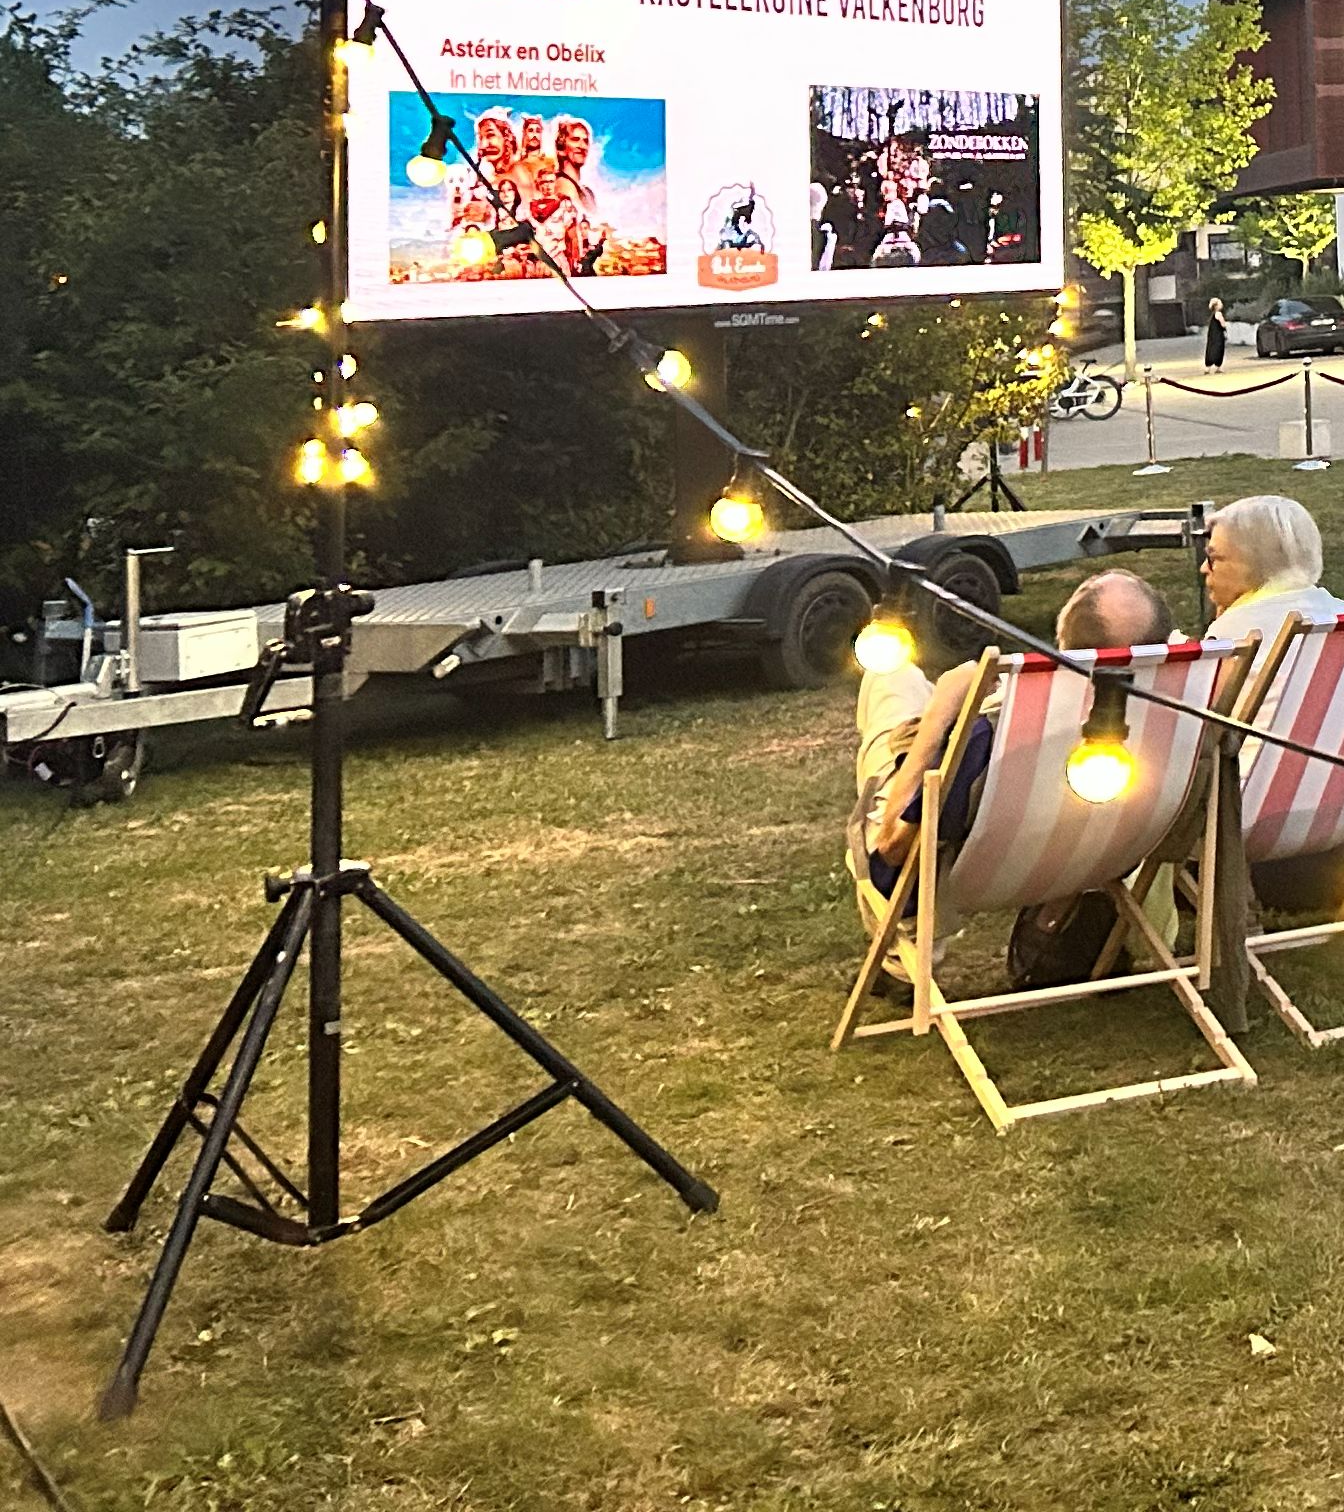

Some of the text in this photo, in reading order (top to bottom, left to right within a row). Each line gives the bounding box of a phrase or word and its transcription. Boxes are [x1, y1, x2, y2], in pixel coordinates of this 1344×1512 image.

[440, 38, 606, 64] Astérix en Obélix
[451, 68, 467, 89] In
[473, 69, 501, 90] het
